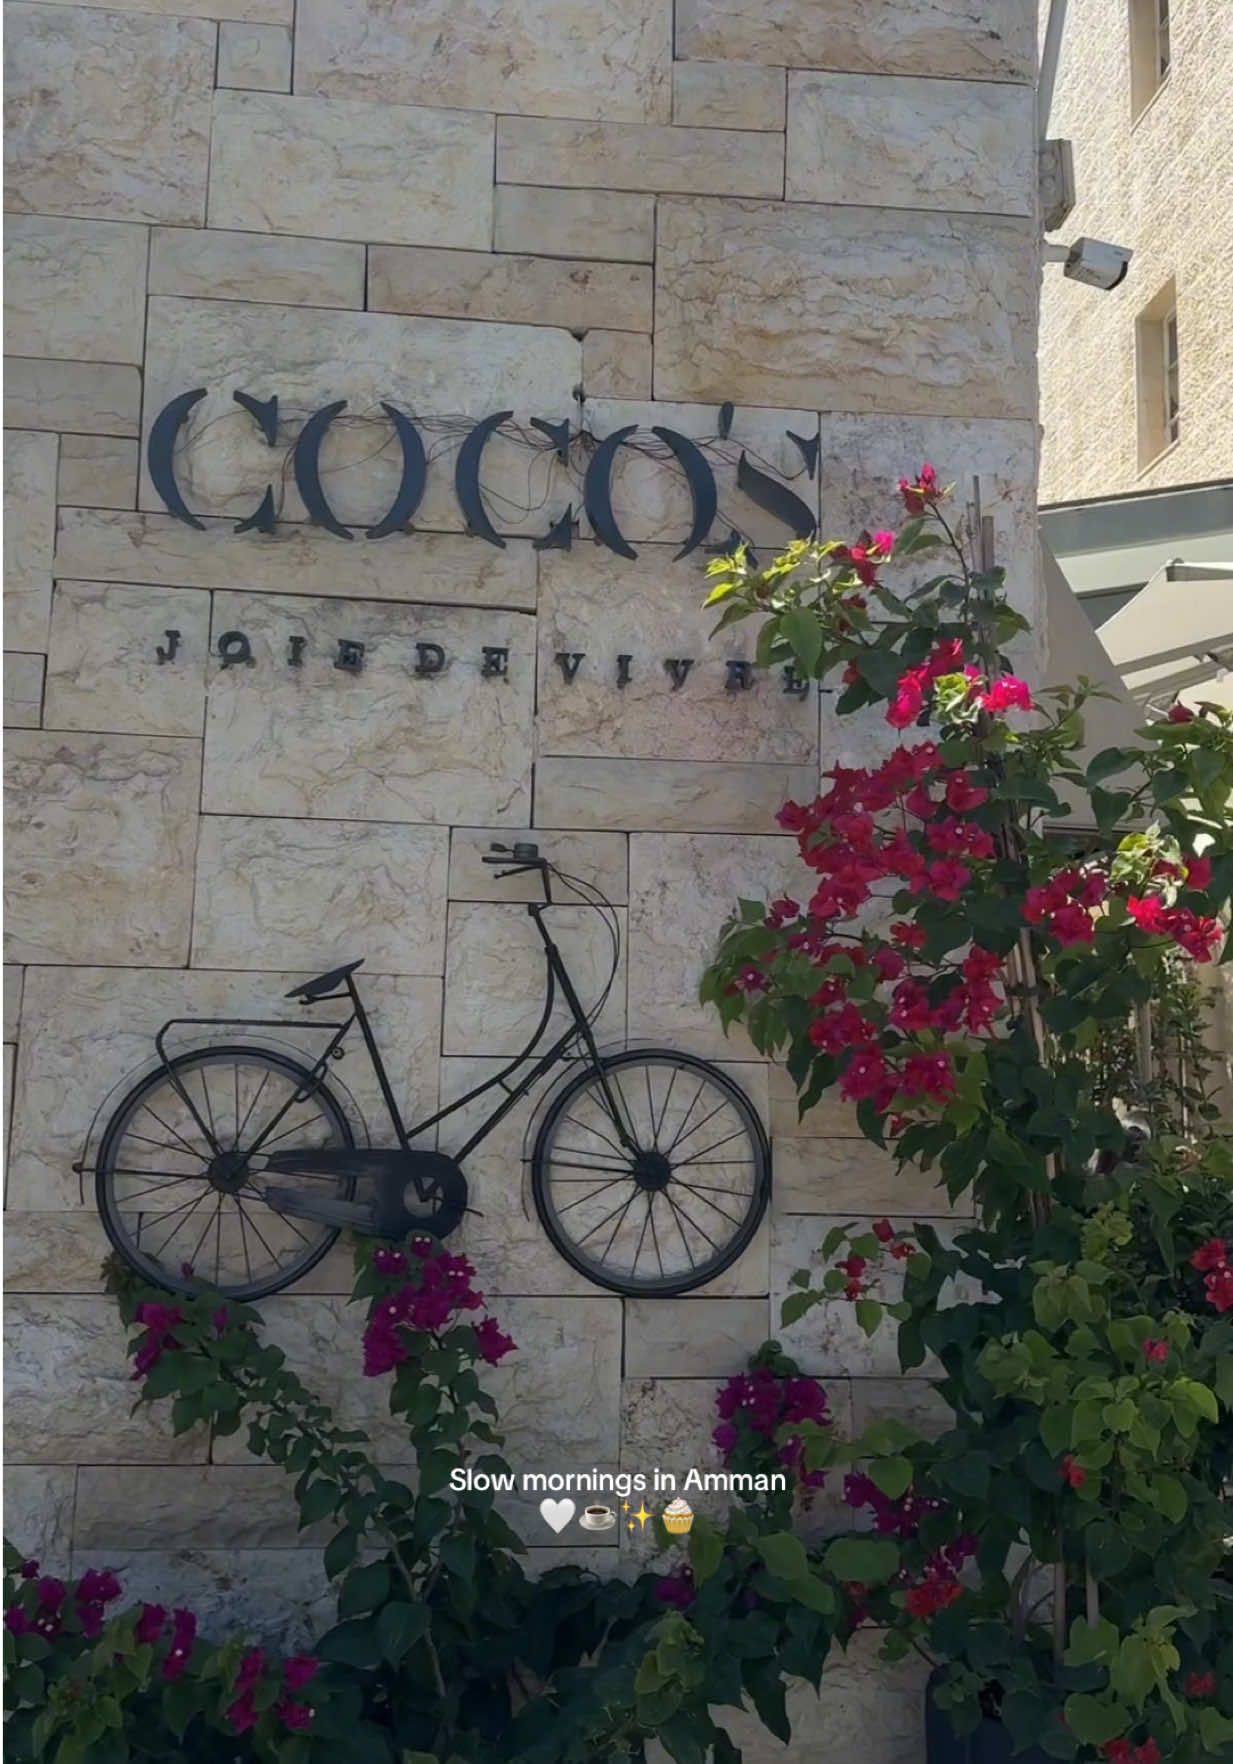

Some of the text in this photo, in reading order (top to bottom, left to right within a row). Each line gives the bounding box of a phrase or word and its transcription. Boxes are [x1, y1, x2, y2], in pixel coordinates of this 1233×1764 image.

[148, 387, 820, 568] COCO'S
[156, 629, 366, 674] JOIE
[414, 642, 510, 678] DE
